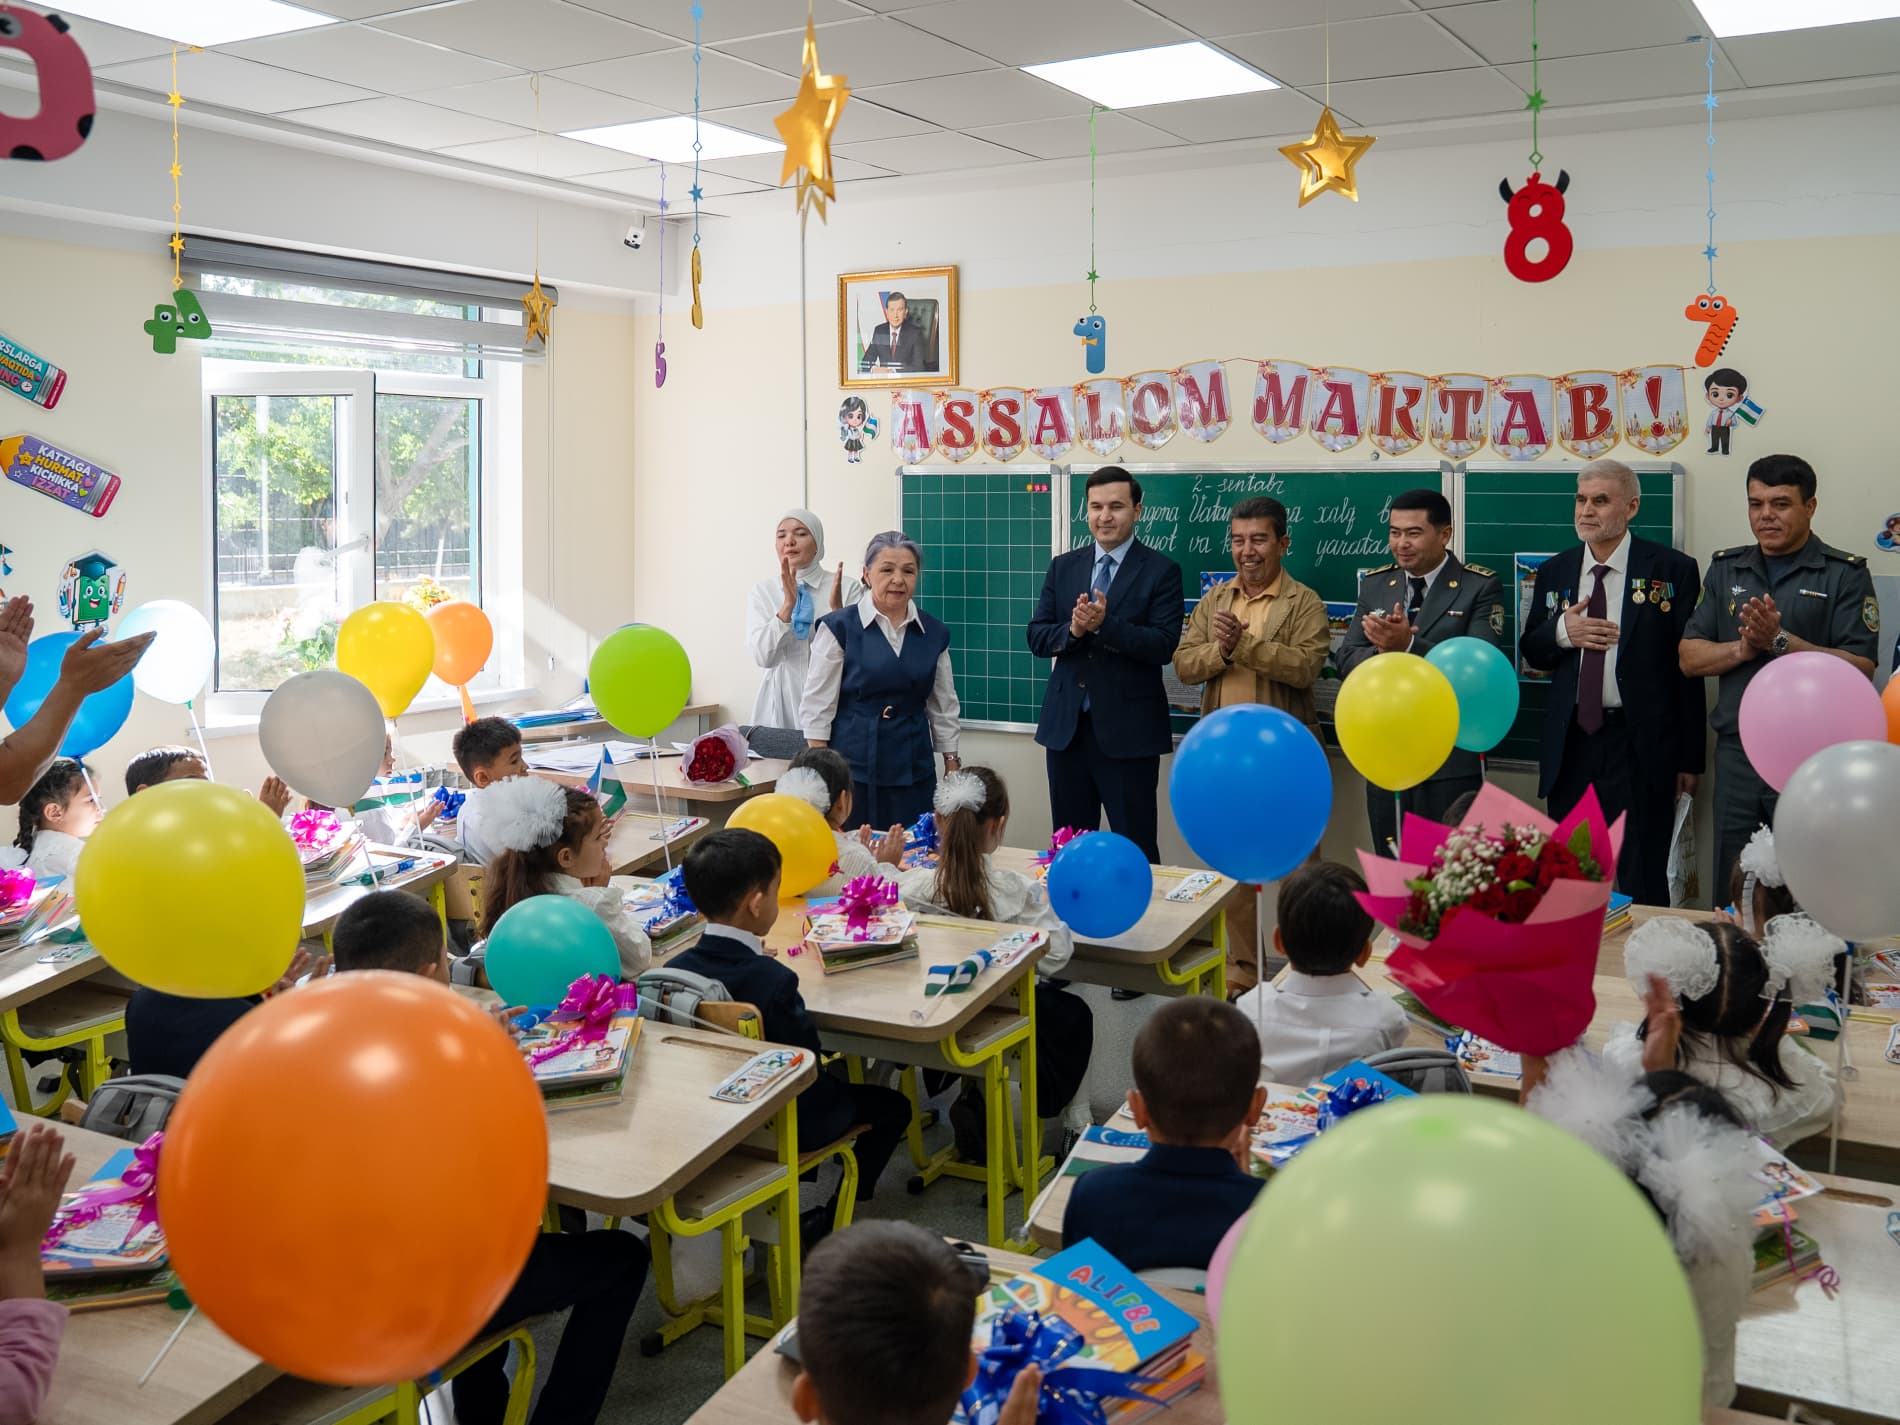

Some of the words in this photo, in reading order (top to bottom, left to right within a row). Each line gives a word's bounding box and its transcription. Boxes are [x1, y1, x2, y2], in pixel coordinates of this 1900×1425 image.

[1502, 171, 1573, 283] 8
[1685, 295, 1738, 368] 7
[897, 368, 1230, 449] ASSALOM
[1255, 372, 1667, 446] MAKTAB!
[30, 464, 79, 492] KICHIKKA
[38, 444, 91, 476] KATTAGA
[31, 476, 71, 499] IZZAT
[1189, 536, 1212, 554] va
[1067, 1265, 1160, 1335] ALIFBE
